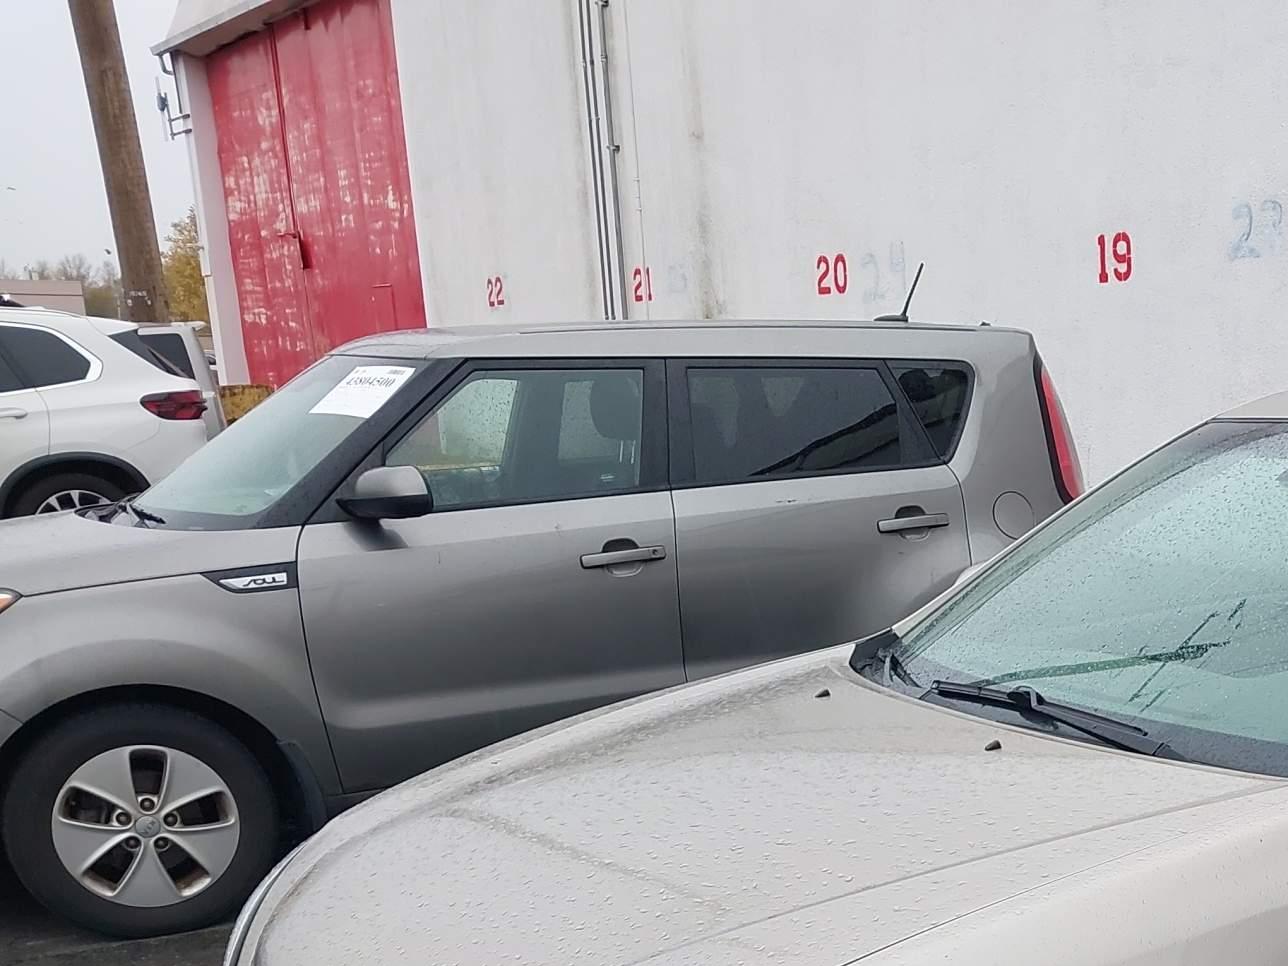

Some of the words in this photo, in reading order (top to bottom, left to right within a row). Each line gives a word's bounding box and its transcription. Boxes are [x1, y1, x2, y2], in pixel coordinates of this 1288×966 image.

[817, 254, 847, 294] 20
[1098, 232, 1132, 283] 19
[487, 277, 504, 307] 22
[633, 267, 652, 302] 21
